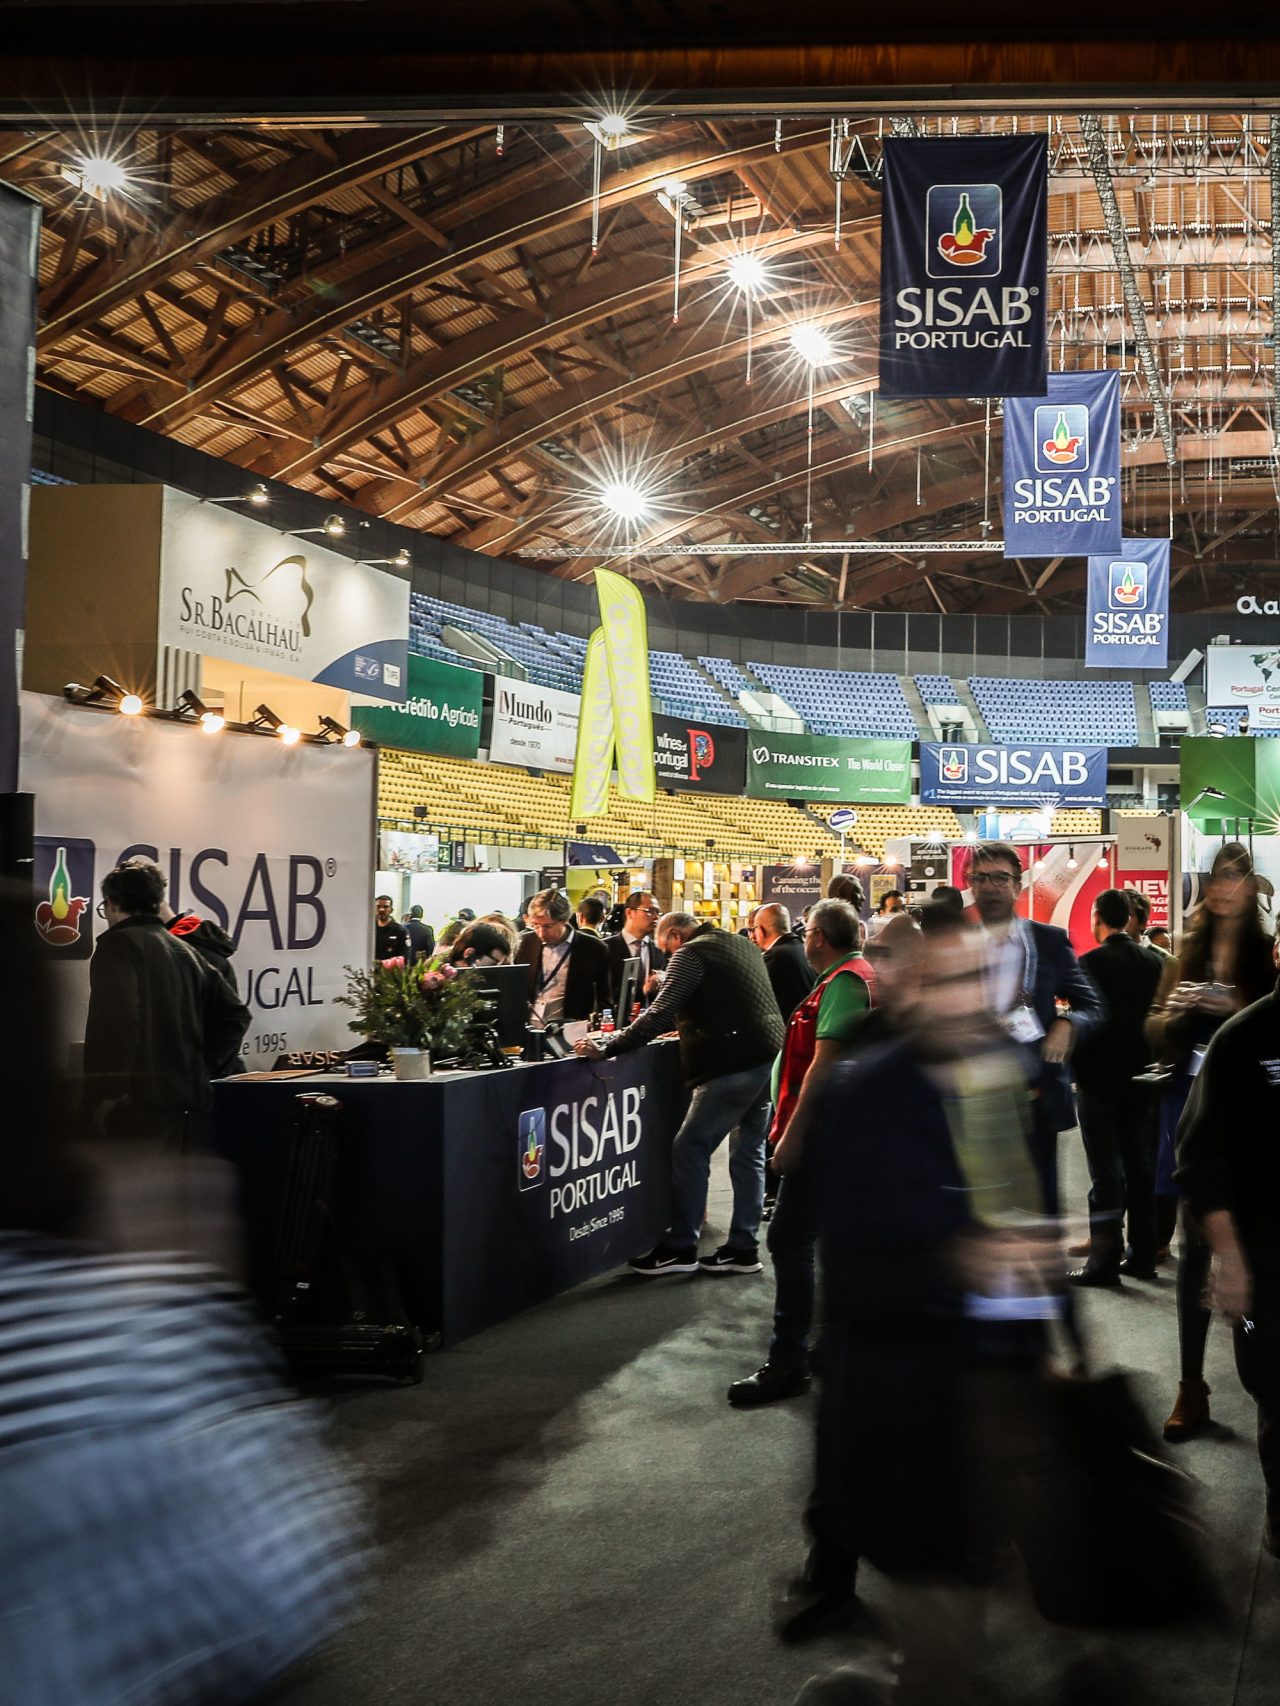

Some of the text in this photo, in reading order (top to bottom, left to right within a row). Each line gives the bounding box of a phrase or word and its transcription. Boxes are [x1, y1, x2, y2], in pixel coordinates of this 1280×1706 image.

[895, 330, 1031, 349] PORTUGAL
[1013, 476, 1112, 508] SISAB
[1014, 508, 1111, 524] PORTUGAL
[1093, 612, 1161, 634] SISAB
[1093, 634, 1160, 645] PORTUGAL
[1231, 685, 1264, 694] Portugal
[440, 702, 479, 728] Agrícola
[498, 690, 552, 724] Mundo
[656, 732, 681, 750] wines
[771, 753, 840, 768] TRANSITEX
[847, 757, 860, 770] The
[861, 758, 883, 772] World
[973, 749, 1089, 786] SISAB
[771, 875, 808, 887] Canning
[782, 885, 796, 894] the
[115, 843, 327, 951] ISAB
[254, 1032, 287, 1052] 1995
[550, 1160, 641, 1219] PORTUGAL
